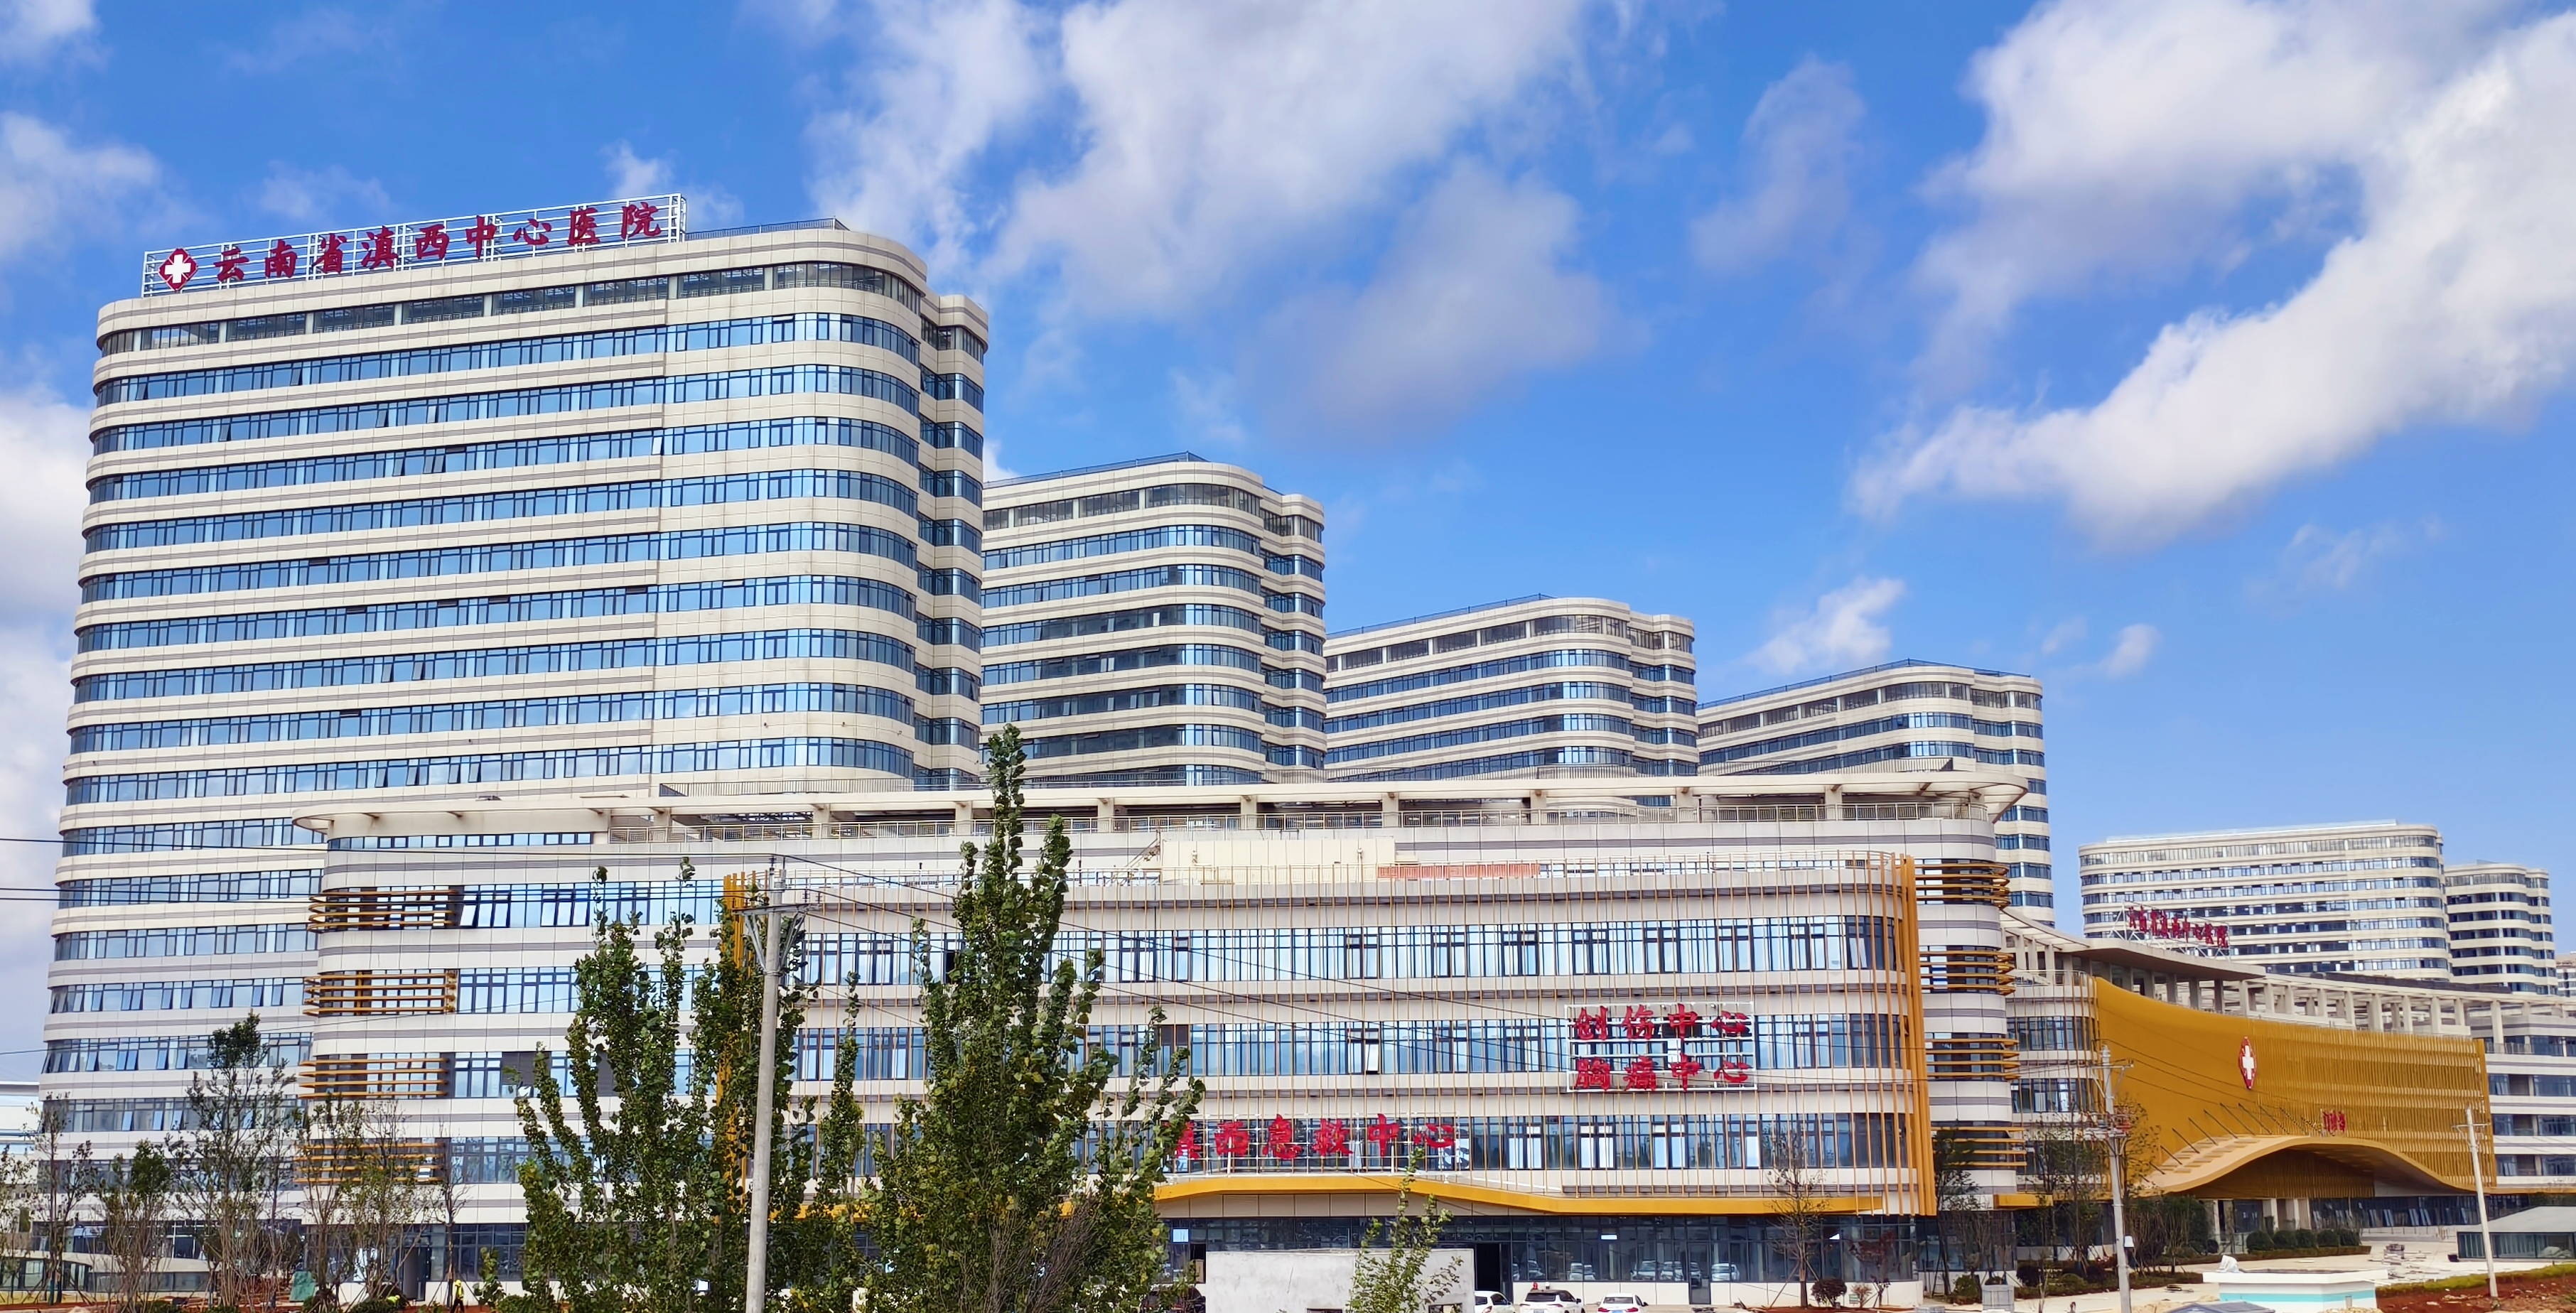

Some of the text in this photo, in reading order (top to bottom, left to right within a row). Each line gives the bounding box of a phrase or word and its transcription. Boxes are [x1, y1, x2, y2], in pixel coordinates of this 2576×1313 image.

[214, 202, 662, 282] 云南省滇西中心医院
[1574, 1003, 1748, 1041] 创伤中心
[1575, 1052, 1750, 1092] 胸痛中心
